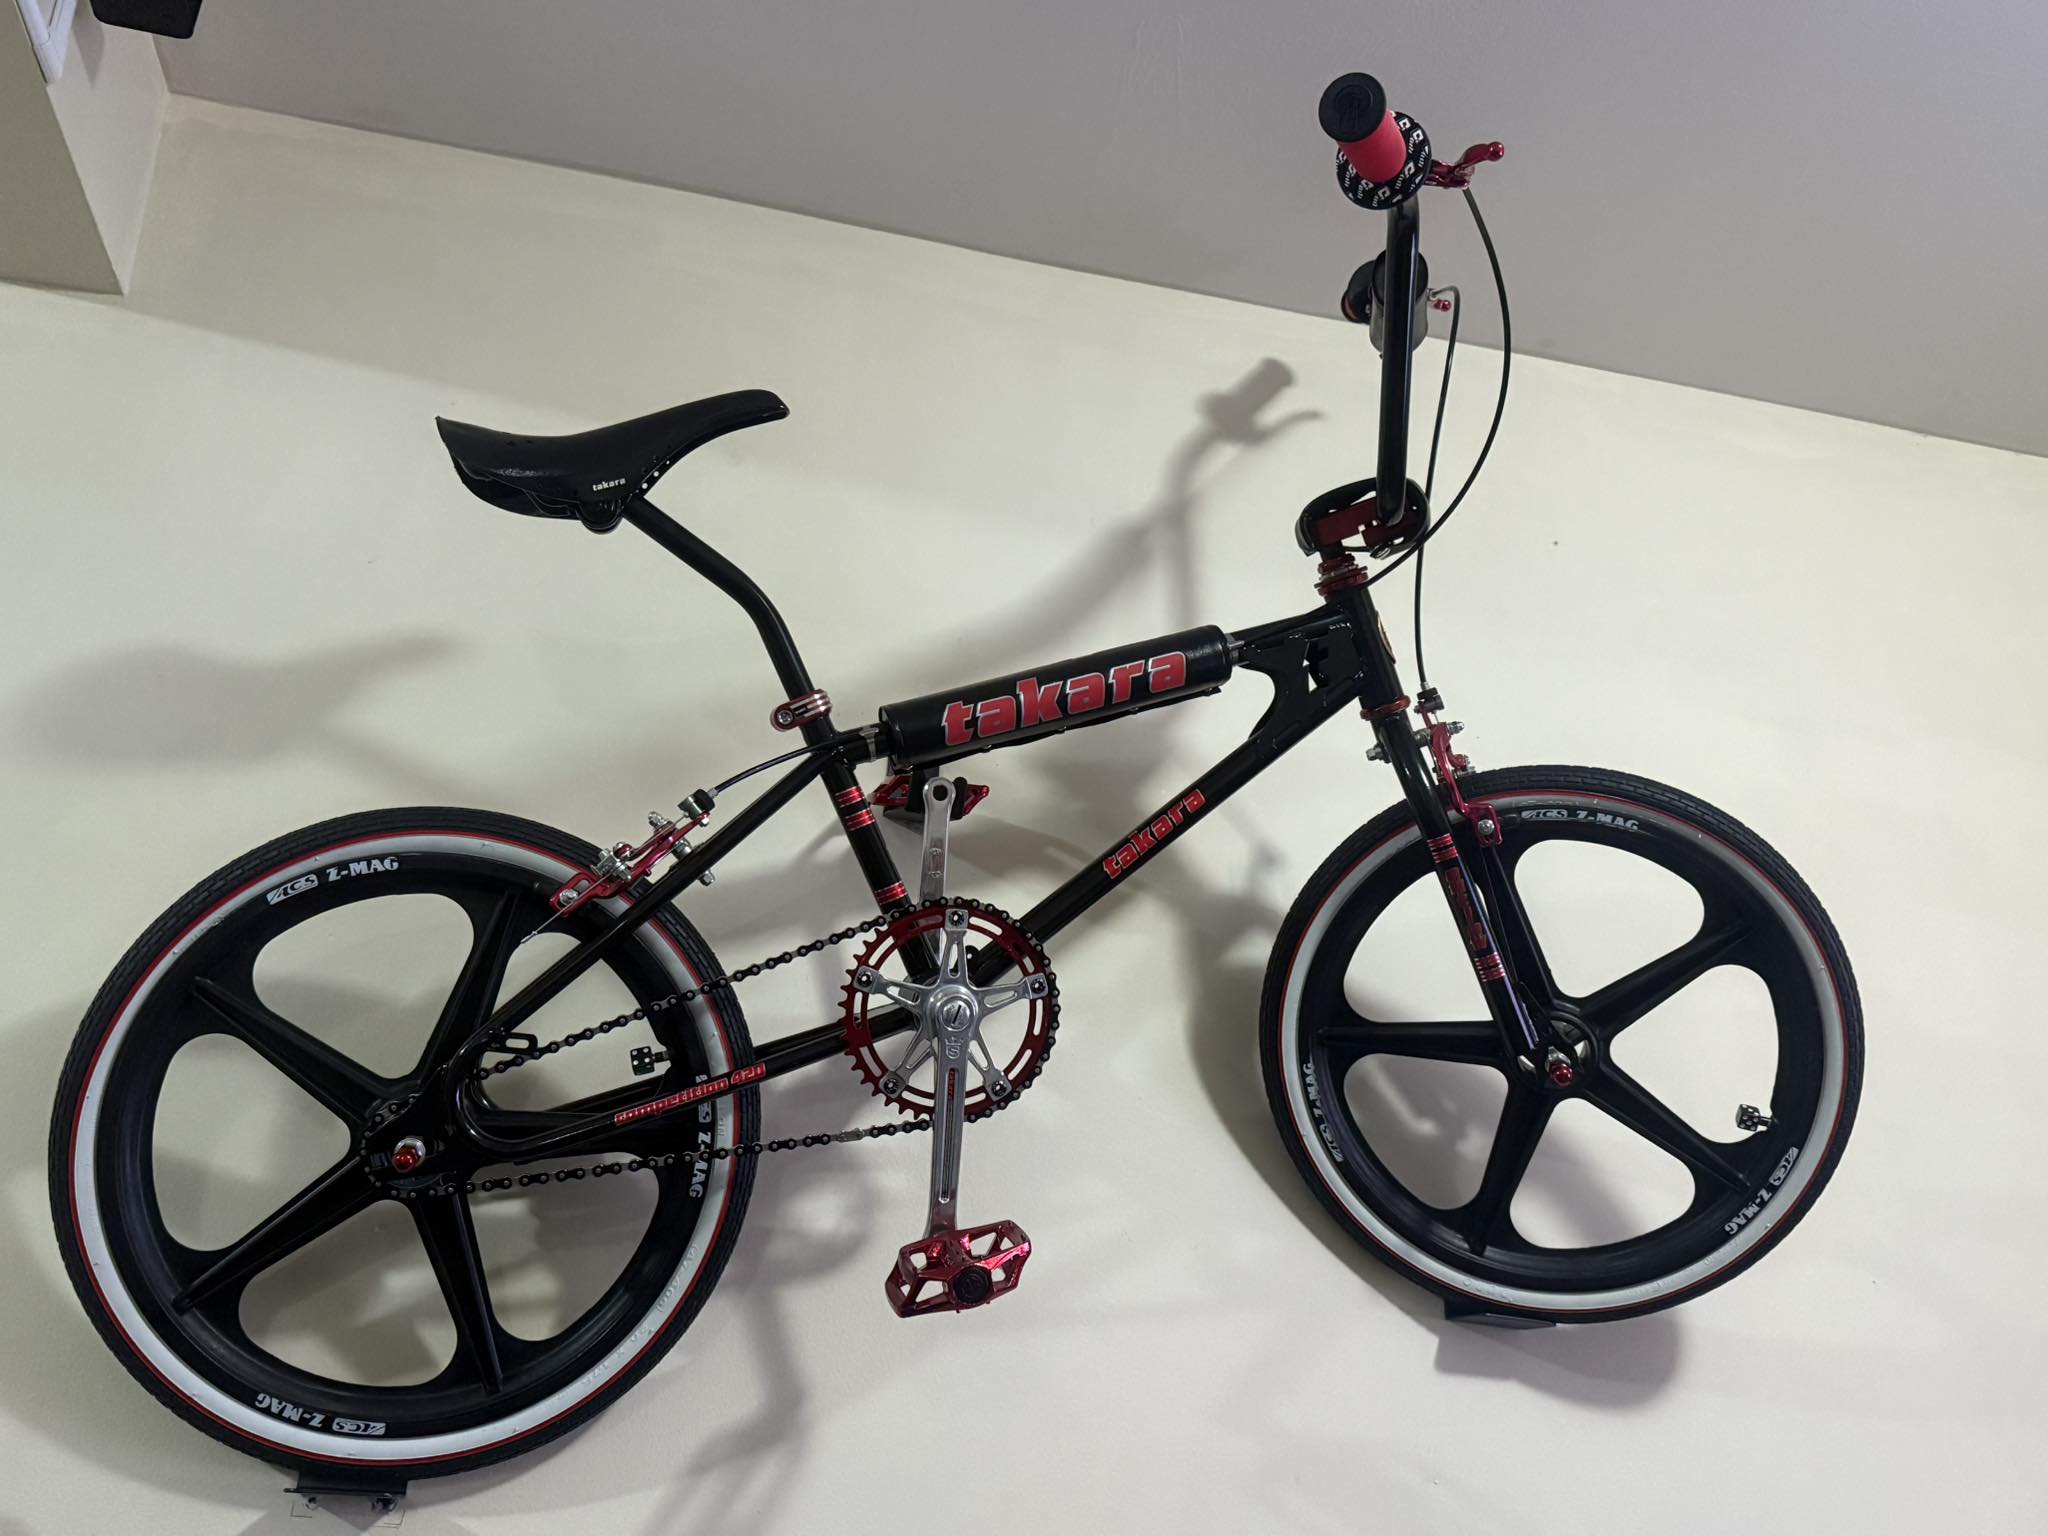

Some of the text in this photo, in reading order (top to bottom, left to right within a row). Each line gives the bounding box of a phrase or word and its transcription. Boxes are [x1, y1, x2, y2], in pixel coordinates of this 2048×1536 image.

[592, 478, 626, 491] takara
[941, 651, 1187, 746] takara
[1102, 788, 1206, 879] takara
[1576, 810, 1640, 831] Z-MAG
[266, 857, 399, 905] ACS Z-MAG
[1724, 1187, 1773, 1235] Z-MAG
[254, 1393, 327, 1428] Z-MAG
